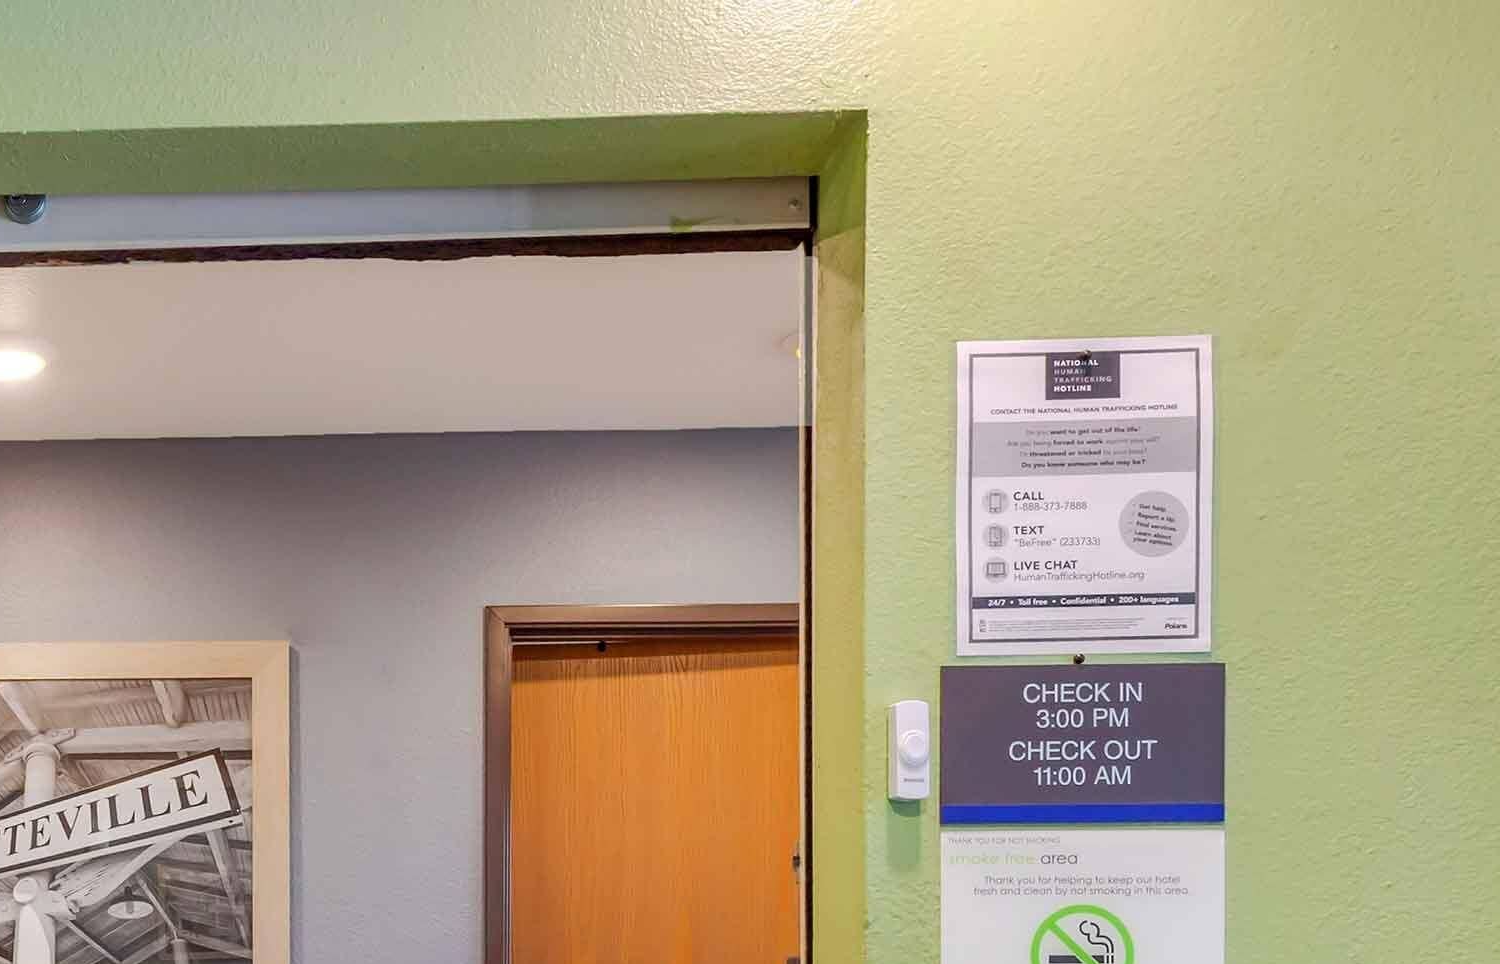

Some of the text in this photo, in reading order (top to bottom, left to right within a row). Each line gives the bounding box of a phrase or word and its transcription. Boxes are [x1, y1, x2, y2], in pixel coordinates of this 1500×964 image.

[1053, 359, 1099, 367] NATIONAL
[990, 407, 1022, 415] CONTACT
[1013, 491, 1044, 501] CALL
[1014, 501, 1088, 511] 1-888-373-7888
[1013, 525, 1044, 535] TEXT
[1013, 560, 1078, 570] LIVE CHAT
[1014, 570, 1145, 582] HumanTraffickingHotline.org
[988, 598, 1006, 607] 24/7
[1032, 598, 1048, 606] free
[1060, 597, 1107, 605] Confidential
[1140, 595, 1180, 605] languages
[1022, 682, 1143, 703] CHECK IN
[1036, 708, 1130, 728] 3:00 PM
[1008, 739, 1158, 761] CHECK OUT
[1032, 765, 1132, 786] 11:00 AM
[1040, 854, 1078, 865] area
[985, 874, 1181, 888] Thank you for helping to keep our hotel
[973, 886, 998, 896] fresh
[1000, 886, 1021, 896] and
[1023, 886, 1052, 896] clean
[1055, 886, 1068, 898] by
[1070, 886, 1087, 896] not
[1089, 886, 1132, 897] smoking
[1134, 886, 1144, 895] in
[1146, 886, 1161, 895] this
